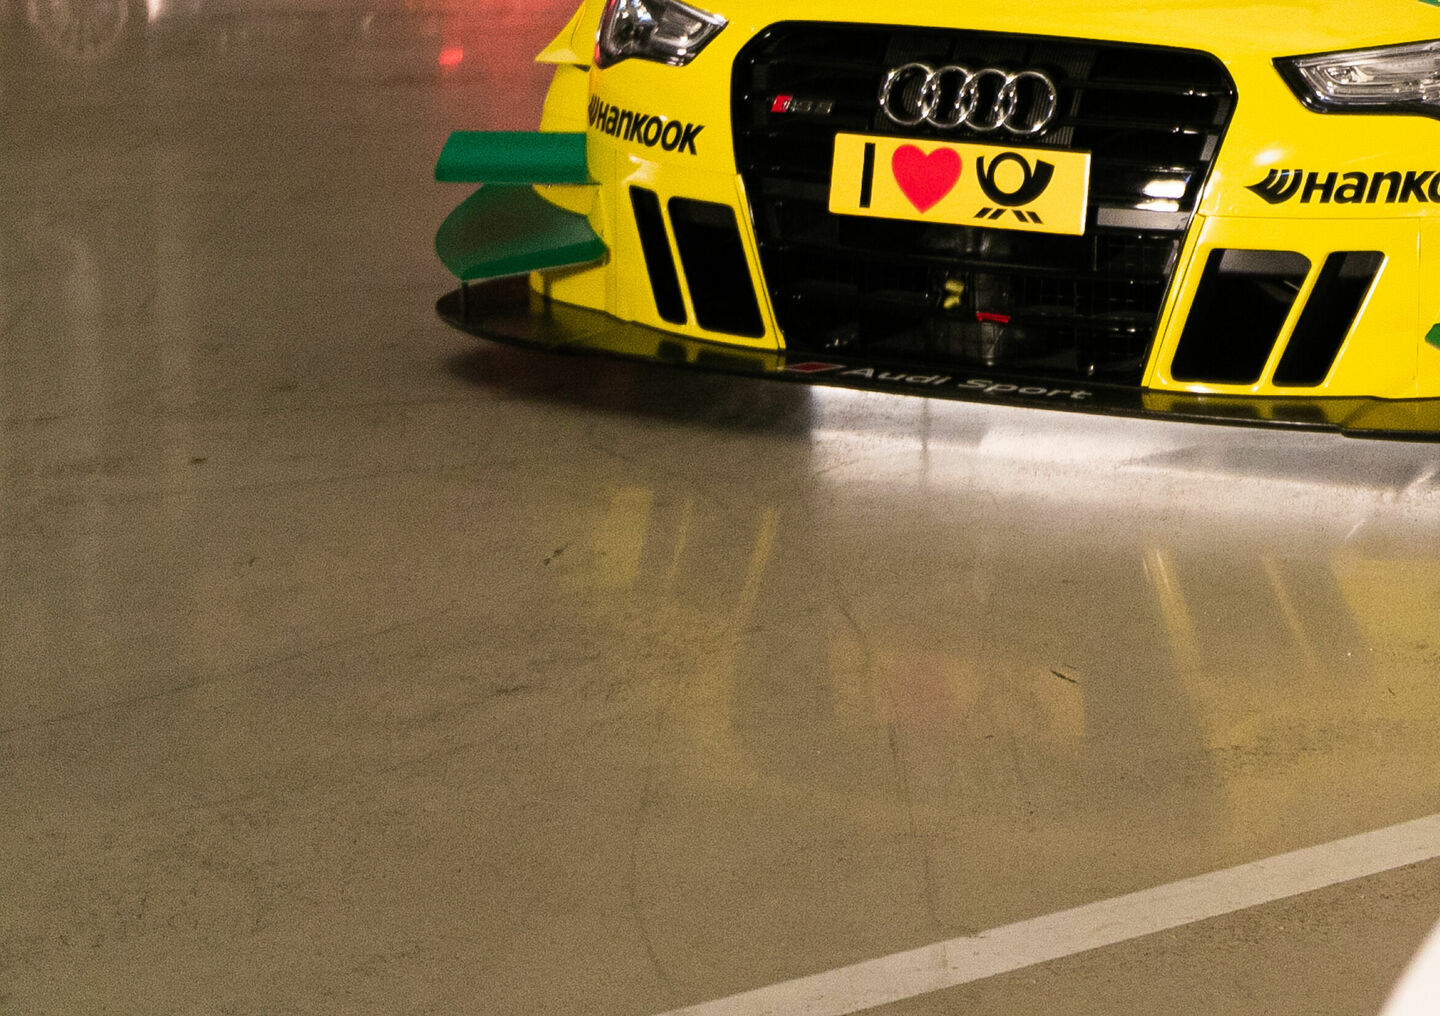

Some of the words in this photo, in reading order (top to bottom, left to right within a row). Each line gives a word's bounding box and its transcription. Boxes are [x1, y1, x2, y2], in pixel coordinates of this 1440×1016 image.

[859, 142, 876, 209] I
[841, 367, 952, 385] Audi
[958, 378, 1093, 400] Sport
